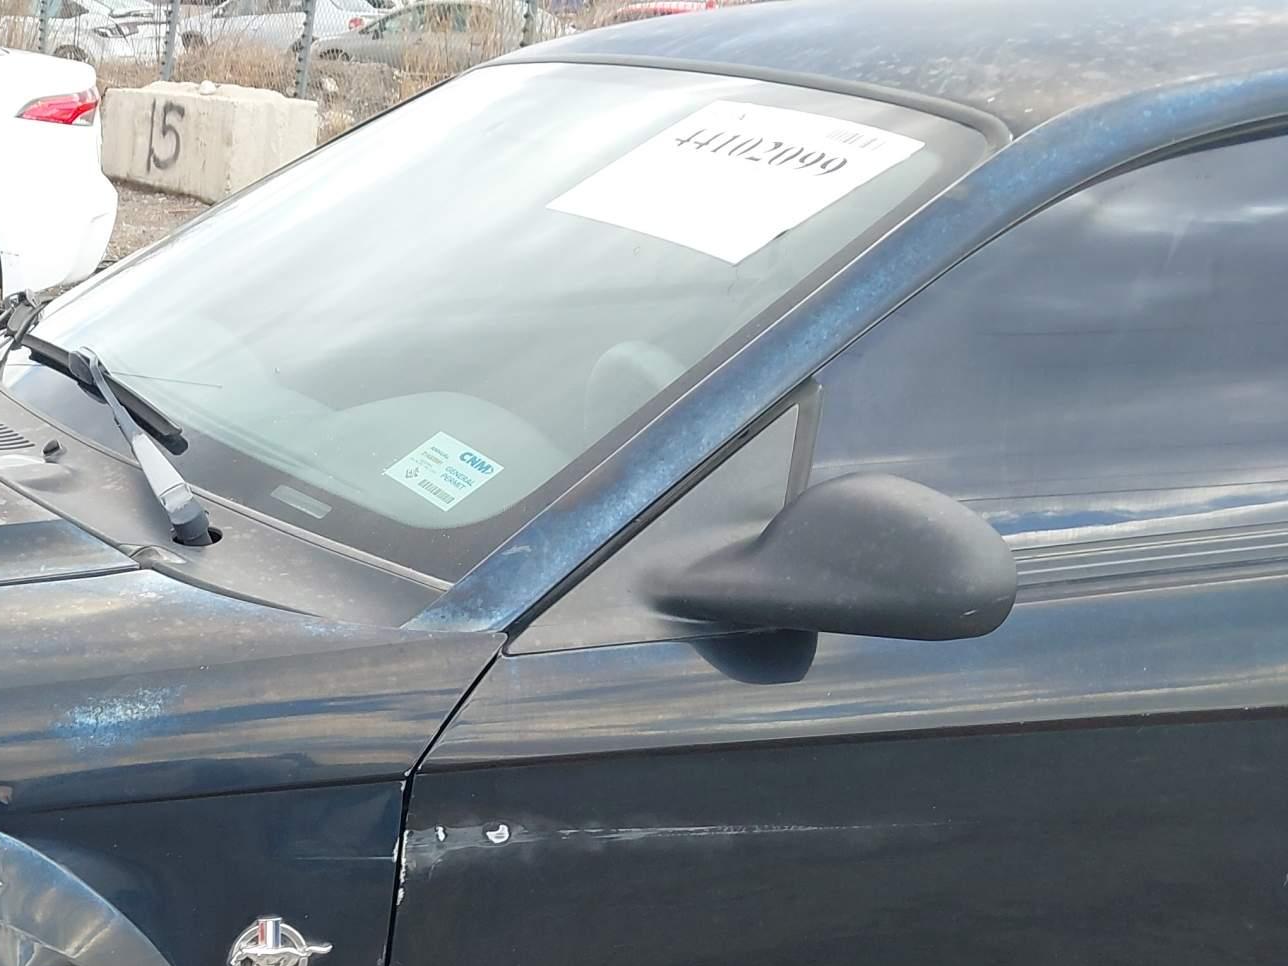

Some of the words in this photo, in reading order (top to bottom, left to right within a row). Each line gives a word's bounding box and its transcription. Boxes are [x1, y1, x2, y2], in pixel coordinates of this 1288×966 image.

[145, 97, 186, 174] 15
[674, 128, 849, 177] 44102099
[459, 451, 491, 475] CNM
